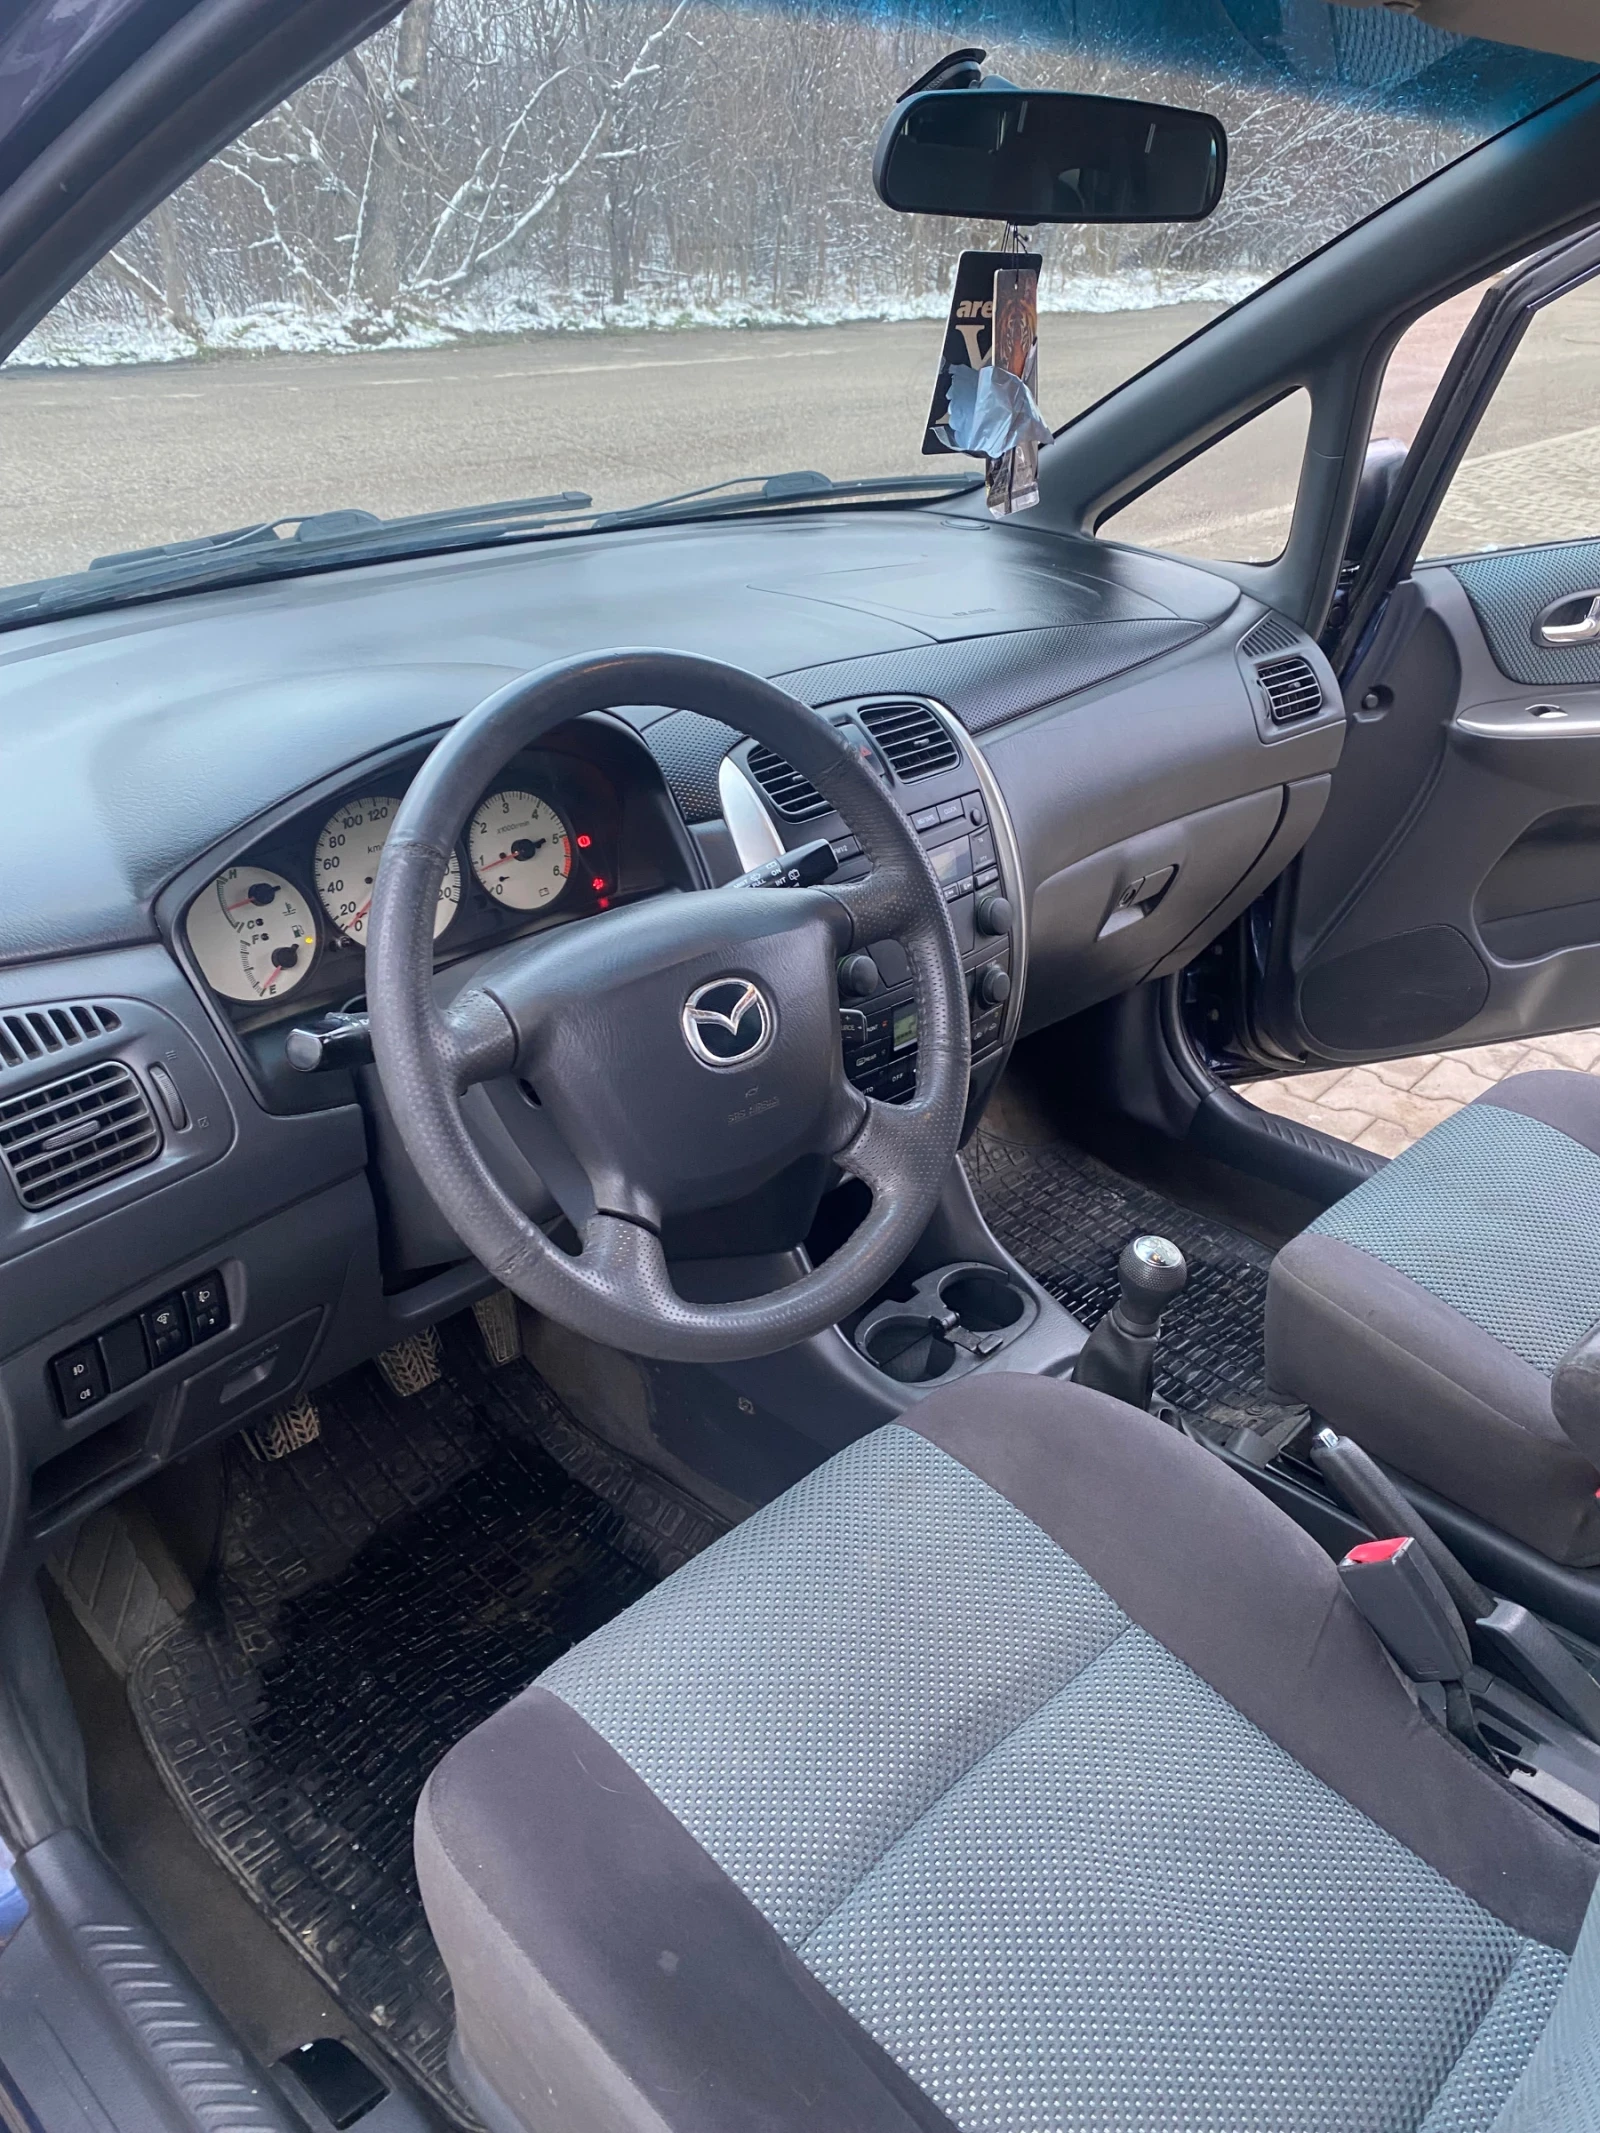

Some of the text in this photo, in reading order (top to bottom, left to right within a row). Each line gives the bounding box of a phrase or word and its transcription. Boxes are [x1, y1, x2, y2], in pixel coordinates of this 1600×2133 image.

[367, 806, 388, 821] 120
[502, 802, 510, 814] 3
[531, 809, 539, 820] 4
[342, 814, 363, 829] 100
[480, 822, 488, 834] 2
[329, 834, 346, 848] 80
[552, 833, 559, 844] 5
[323, 856, 340, 870] 60
[480, 855, 484, 866] 1
[229, 869, 238, 879] H
[553, 865, 560, 876] 6
[771, 868, 782, 876] ON
[327, 879, 344, 893] 40
[775, 877, 787, 886] INT
[438, 887, 452, 900] 20
[496, 884, 503, 895] 0
[340, 901, 356, 916] 20
[247, 921, 255, 929] C
[354, 920, 363, 932] 0
[252, 935, 259, 944] F
[269, 985, 277, 995] E
[892, 1073, 903, 1082] OFF
